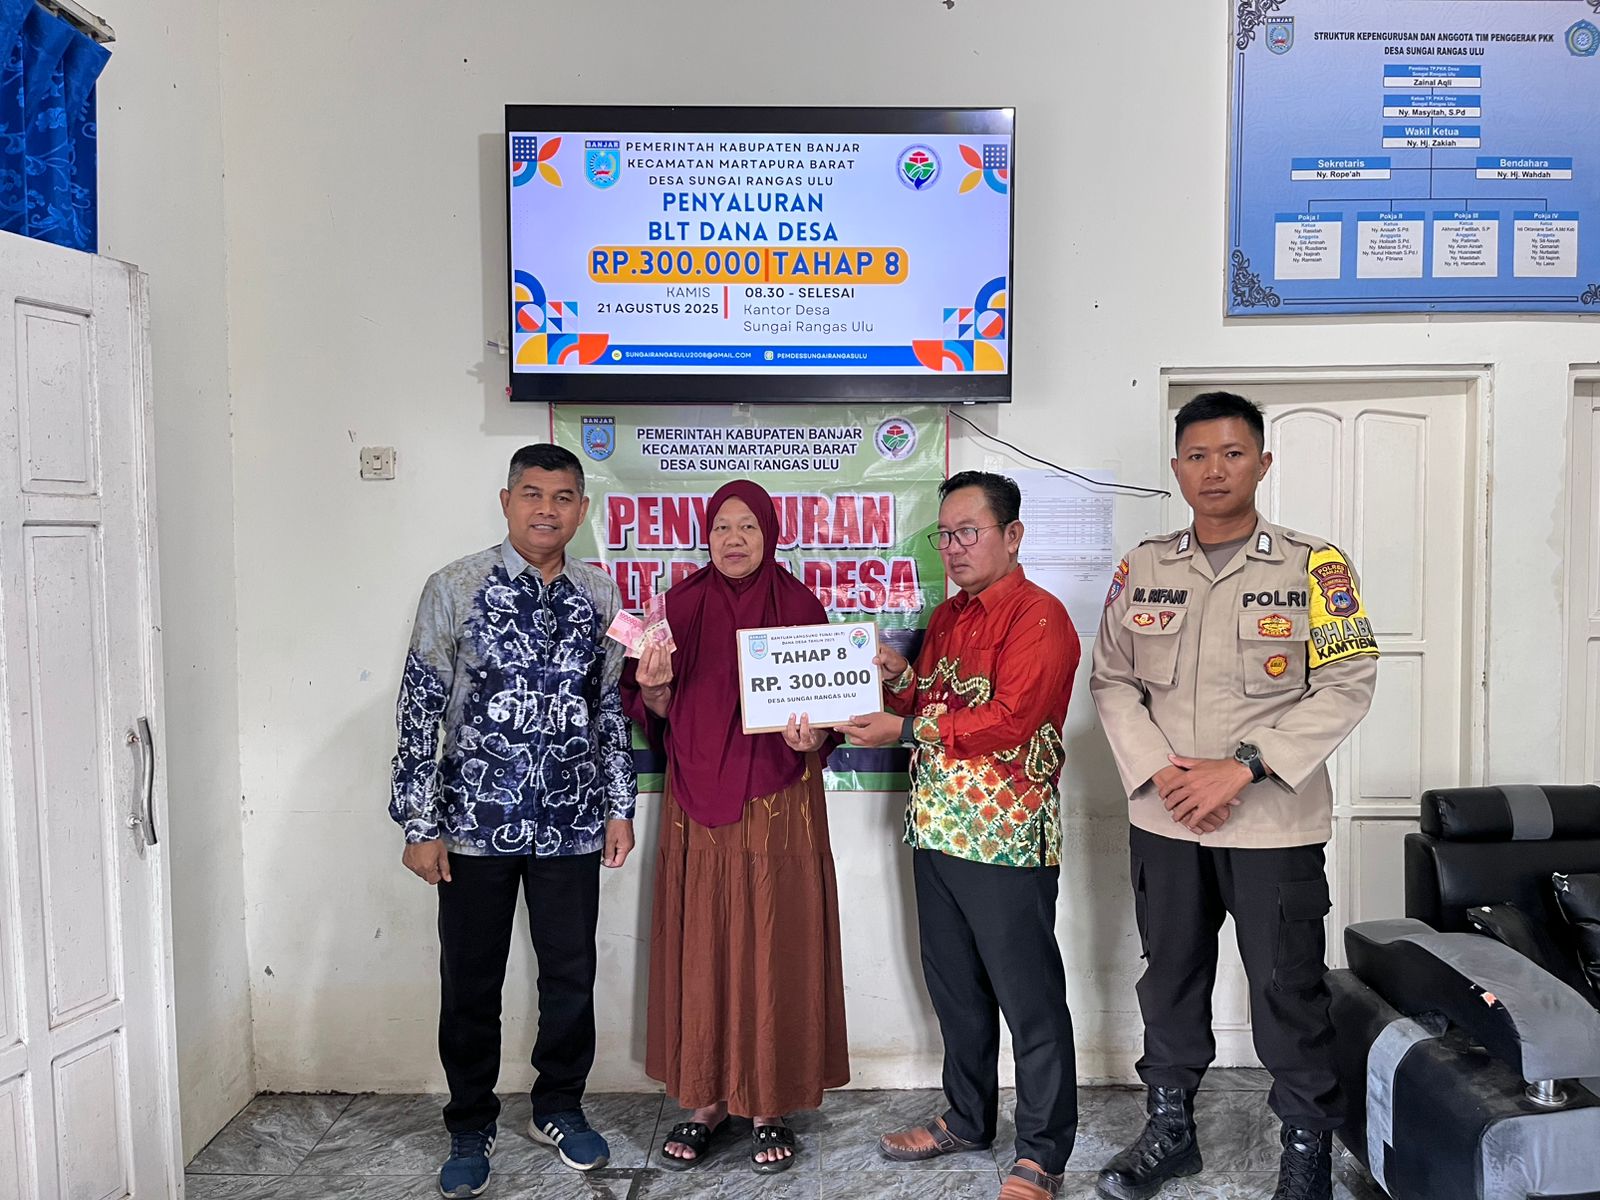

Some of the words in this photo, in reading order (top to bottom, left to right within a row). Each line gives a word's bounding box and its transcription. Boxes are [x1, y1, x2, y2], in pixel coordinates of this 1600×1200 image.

[1314, 32, 1355, 40] STRUKTUR
[1356, 32, 1418, 41] KEPENGURUSAN
[1420, 32, 1436, 41] DAN
[1437, 32, 1474, 42] ANGGOTA
[1475, 33, 1488, 42] TIM
[1490, 34, 1536, 42] PENGGERAK
[1538, 34, 1554, 42] PKK
[1384, 46, 1404, 55] DESA
[1406, 46, 1434, 56] SUNGAI
[1436, 47, 1468, 56] RANGAS
[1469, 47, 1484, 56] ULU
[1437, 79, 1452, 88] Aqli
[1398, 109, 1410, 117] Ny.
[1412, 109, 1446, 117] Masyitah,
[1404, 128, 1430, 136] Wakil
[1432, 128, 1459, 136] Ketua
[586, 140, 619, 148] BANJAR
[626, 142, 714, 152] PEMERINTAH
[719, 142, 801, 152] KABUPATEN
[807, 143, 860, 153] BANJAR
[1406, 140, 1418, 148] Ny.
[1420, 140, 1430, 148] Hj.
[628, 158, 714, 168] KECAMATAN
[719, 160, 804, 169] MARTAPURA
[810, 160, 855, 170] BARAT
[1318, 159, 1365, 168] Sekretaris
[1500, 158, 1549, 168] Bendahara
[1330, 170, 1361, 178] Rope'ah
[1497, 171, 1509, 179] Ny.
[1510, 171, 1520, 179] Hj.
[649, 176, 684, 186] DESA
[689, 176, 741, 186] SUNGAI
[746, 176, 802, 186] RANGAS
[808, 176, 834, 186] ULU
[663, 192, 823, 212] PENYALURAN
[649, 222, 690, 241] BLT
[700, 222, 768, 242] DANA
[778, 222, 838, 242] DESA
[592, 250, 761, 276] RP.300.000
[772, 250, 874, 276] TAHAP
[884, 251, 900, 276] 8
[666, 287, 710, 298] KAMIS
[745, 288, 785, 298] 08.30
[798, 288, 855, 298] SELESAI
[597, 303, 612, 314] 21
[615, 303, 681, 314] AGUSTUS
[684, 303, 719, 314] 2025
[744, 304, 792, 316] Kantor
[796, 304, 830, 316] Desa
[743, 321, 792, 334] Sungai
[796, 321, 848, 334] Rangas
[852, 321, 874, 332] Ulu
[637, 428, 722, 440] PEMERINTAH
[726, 428, 804, 440] KABUPATEN
[808, 428, 862, 440] BANJAR
[642, 444, 724, 456] KECAMATAN
[728, 444, 810, 456] MARTAPURA
[813, 444, 858, 454] BARAT
[660, 460, 696, 470] DESA
[700, 460, 750, 470] SUNGAI
[754, 460, 809, 470] RANGAS
[813, 459, 840, 470] ULU
[607, 495, 891, 546] PENYURAN
[1318, 564, 1344, 574] POLRES
[586, 561, 659, 611] LT
[804, 560, 916, 610] DESA
[1132, 588, 1146, 602] M.
[1148, 588, 1188, 604] RIFANI
[1242, 590, 1306, 608] POLRI
[771, 648, 831, 664] TAHAP
[837, 648, 847, 660] 8
[751, 676, 782, 692] RP.
[789, 669, 871, 690] 300.000
